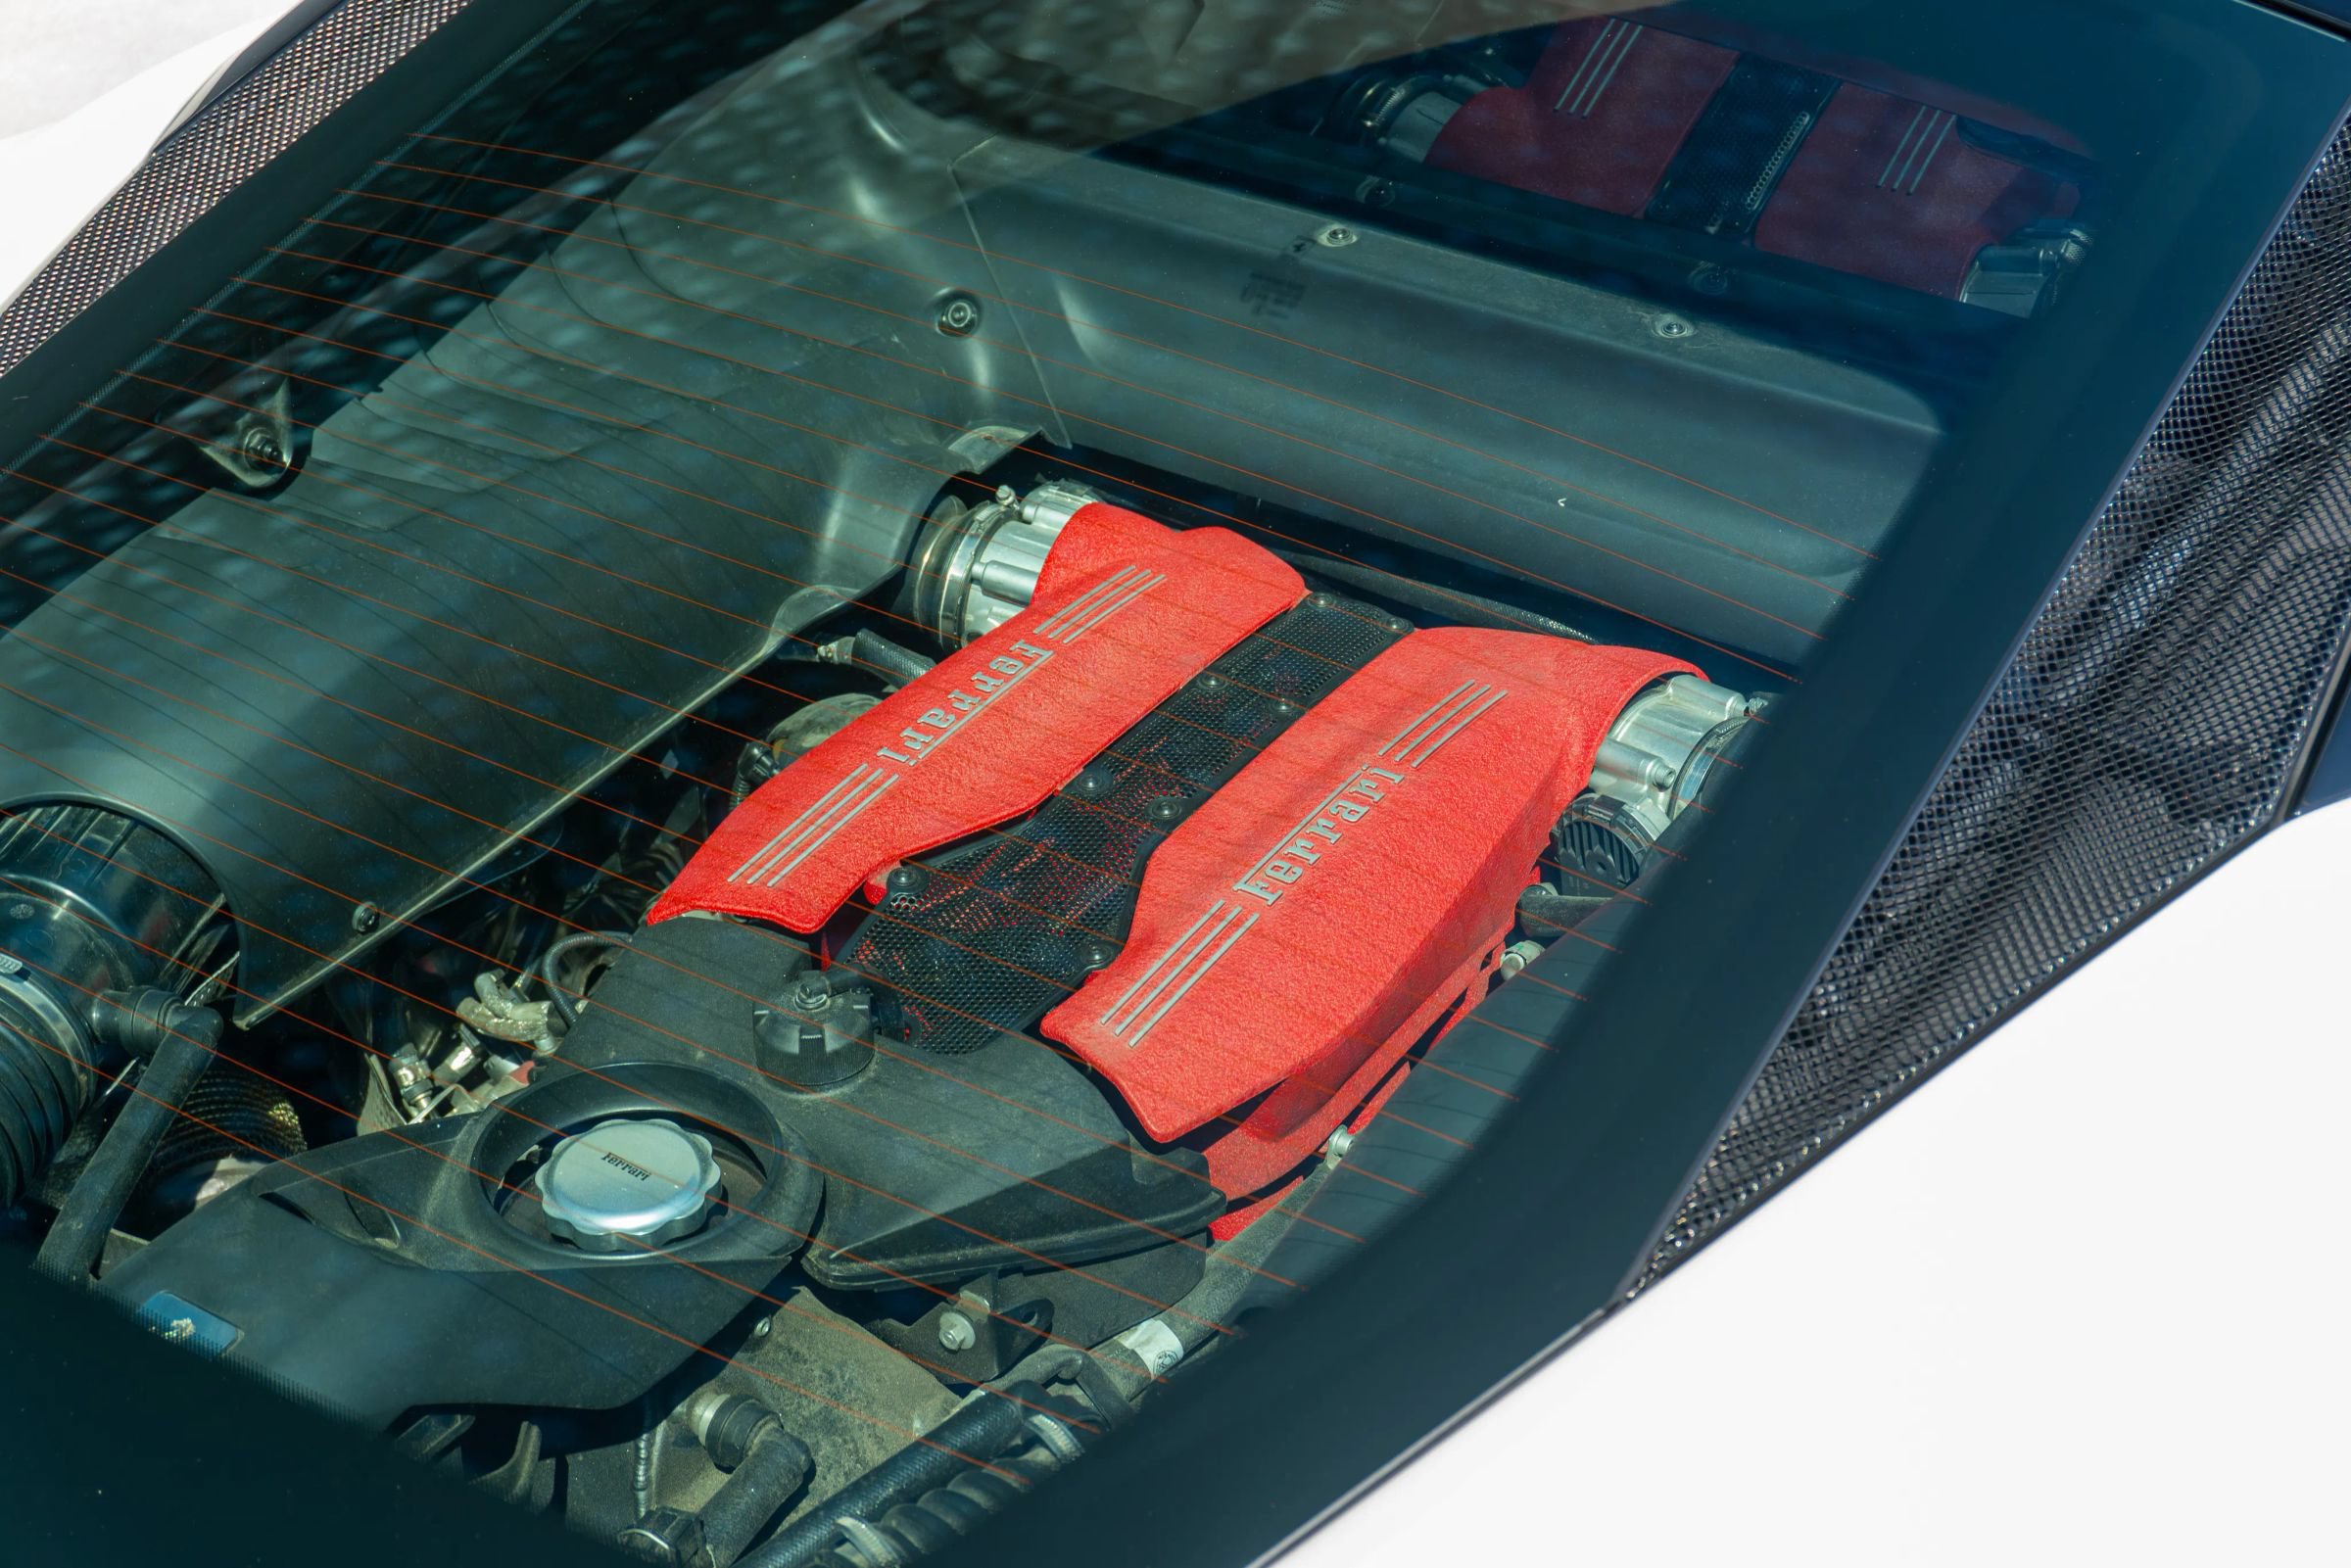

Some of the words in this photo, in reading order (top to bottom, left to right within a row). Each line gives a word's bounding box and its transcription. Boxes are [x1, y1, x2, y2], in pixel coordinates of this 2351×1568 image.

[877, 639, 1054, 766] Ferrari
[1232, 763, 1405, 906] Ferrari
[600, 1152, 651, 1181] Ferrari
